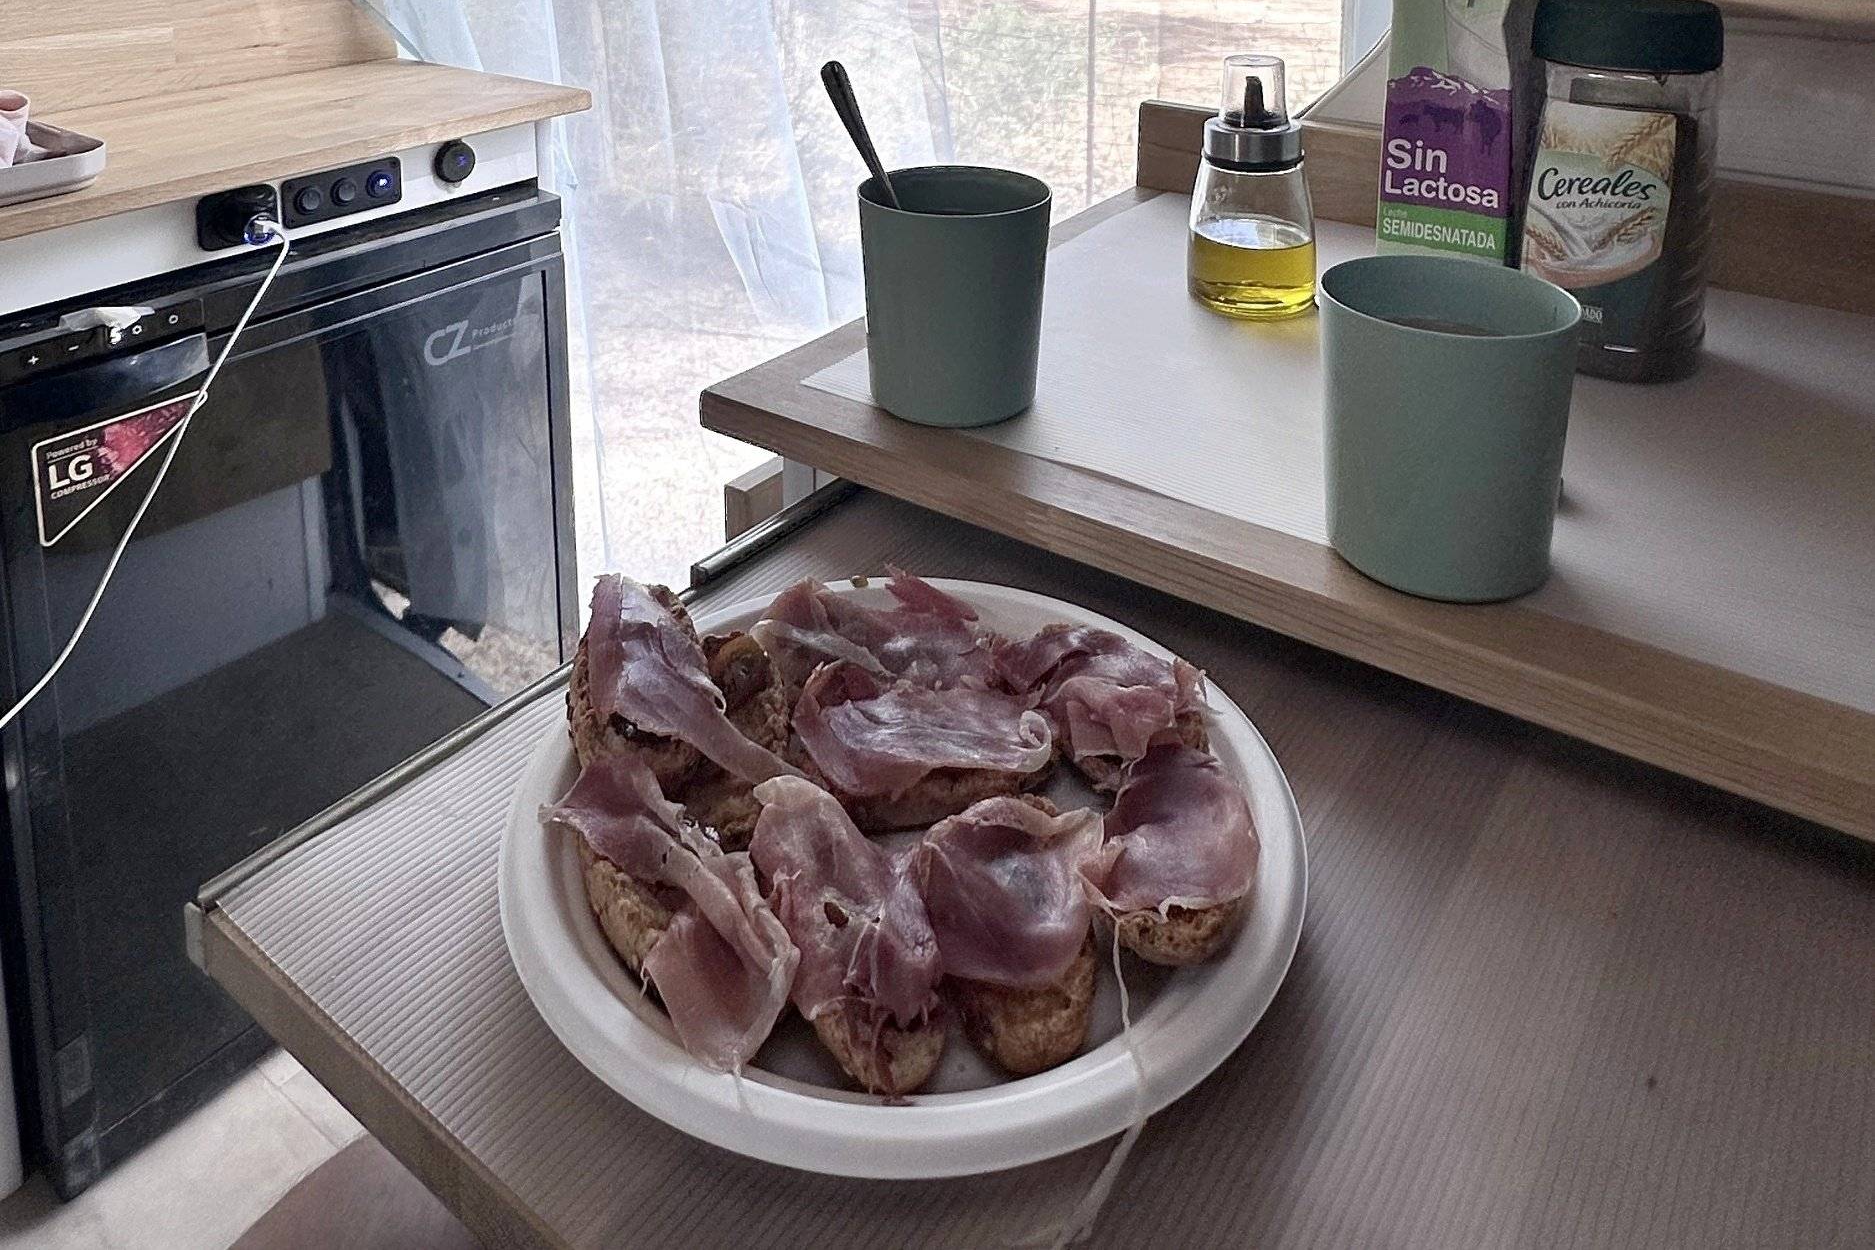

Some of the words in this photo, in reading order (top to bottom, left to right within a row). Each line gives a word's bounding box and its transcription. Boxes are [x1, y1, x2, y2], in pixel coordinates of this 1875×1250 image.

[1386, 138, 1448, 174] Sin
[1384, 169, 1499, 209] Lactosa
[1537, 167, 1657, 201] Cereales
[1555, 200, 1576, 210] con
[1579, 197, 1641, 210] Achicoria
[1382, 217, 1496, 251] SEMIDESNATADA
[46, 441, 85, 460] Powered
[85, 438, 98, 448] by
[48, 453, 94, 491] LG
[50, 473, 111, 500] COMPRESSOR
